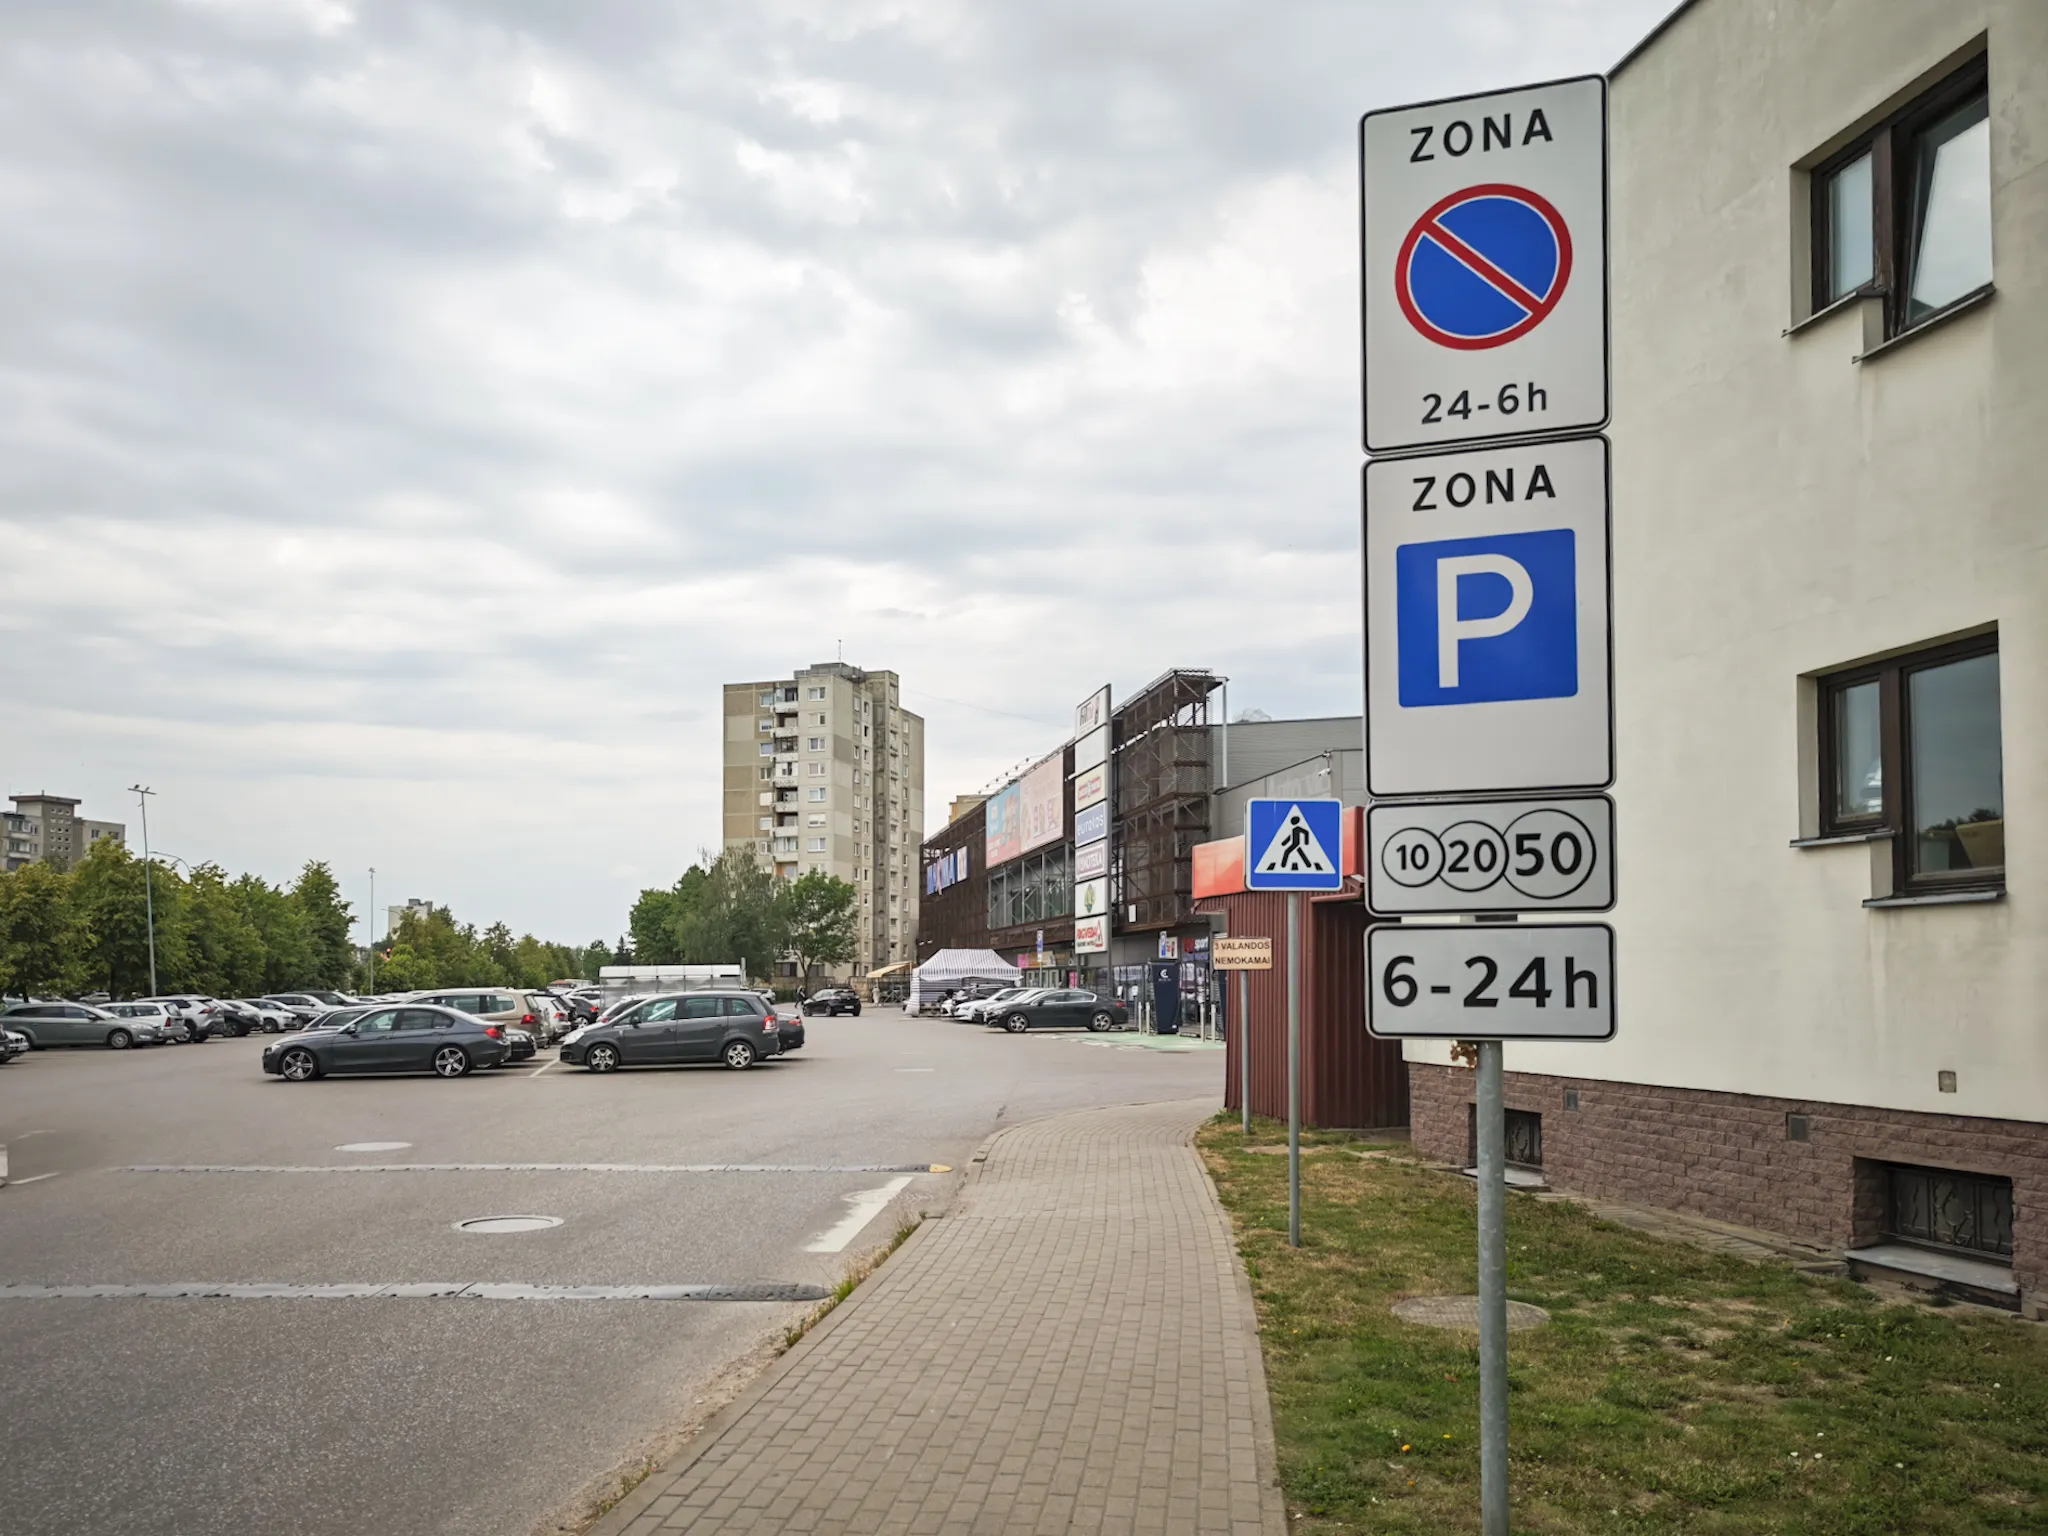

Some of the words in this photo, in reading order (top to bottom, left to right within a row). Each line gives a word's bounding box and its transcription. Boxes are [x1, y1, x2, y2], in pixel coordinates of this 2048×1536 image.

[1410, 108, 1553, 163] ZONA
[1421, 382, 1547, 425] 24-6h
[1412, 464, 1556, 512] ZONA
[1438, 554, 1533, 690] P
[1396, 843, 1430, 871] 10
[1448, 838, 1497, 873] 20
[1515, 831, 1582, 877] 50
[1214, 942, 1219, 950] 3
[1221, 941, 1270, 950] VALANDOS
[1215, 956, 1270, 965] NEMOKAMAI
[1383, 955, 1598, 1008] 6-24h
